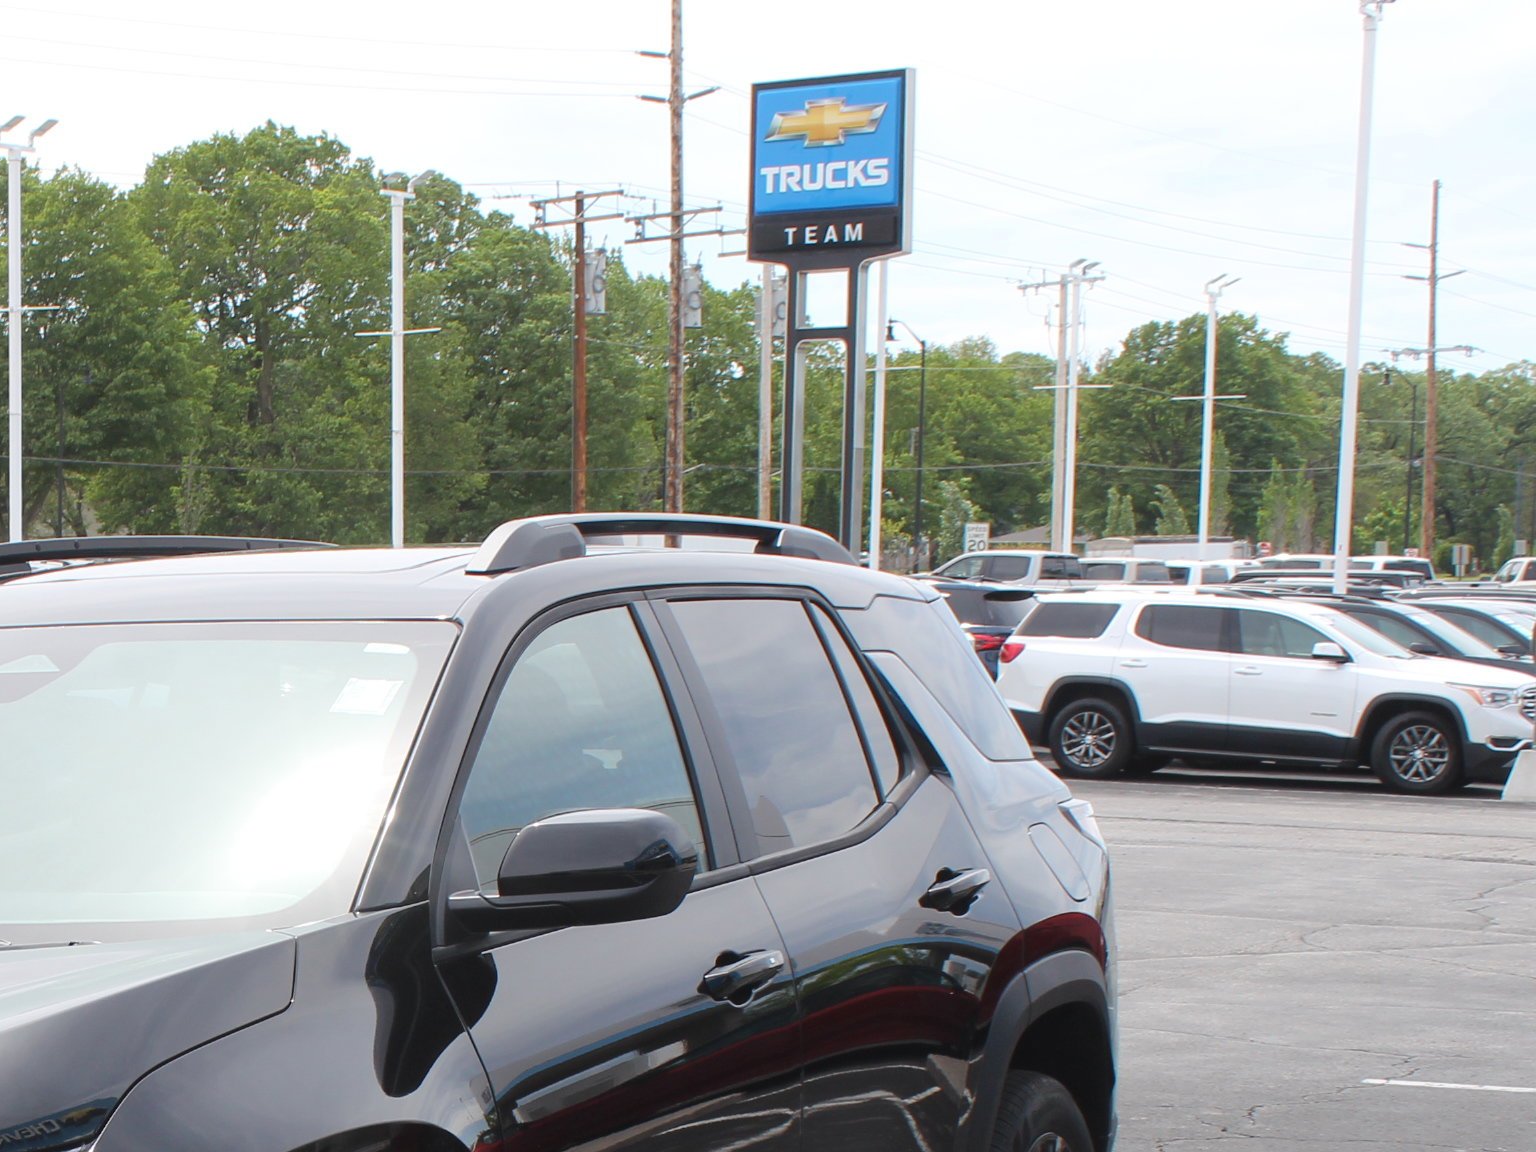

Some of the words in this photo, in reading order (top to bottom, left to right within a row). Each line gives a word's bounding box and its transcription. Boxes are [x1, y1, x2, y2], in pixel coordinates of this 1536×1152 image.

[760, 157, 889, 194] TRUCKS
[784, 223, 863, 246] TEAM
[967, 539, 986, 551] 20
